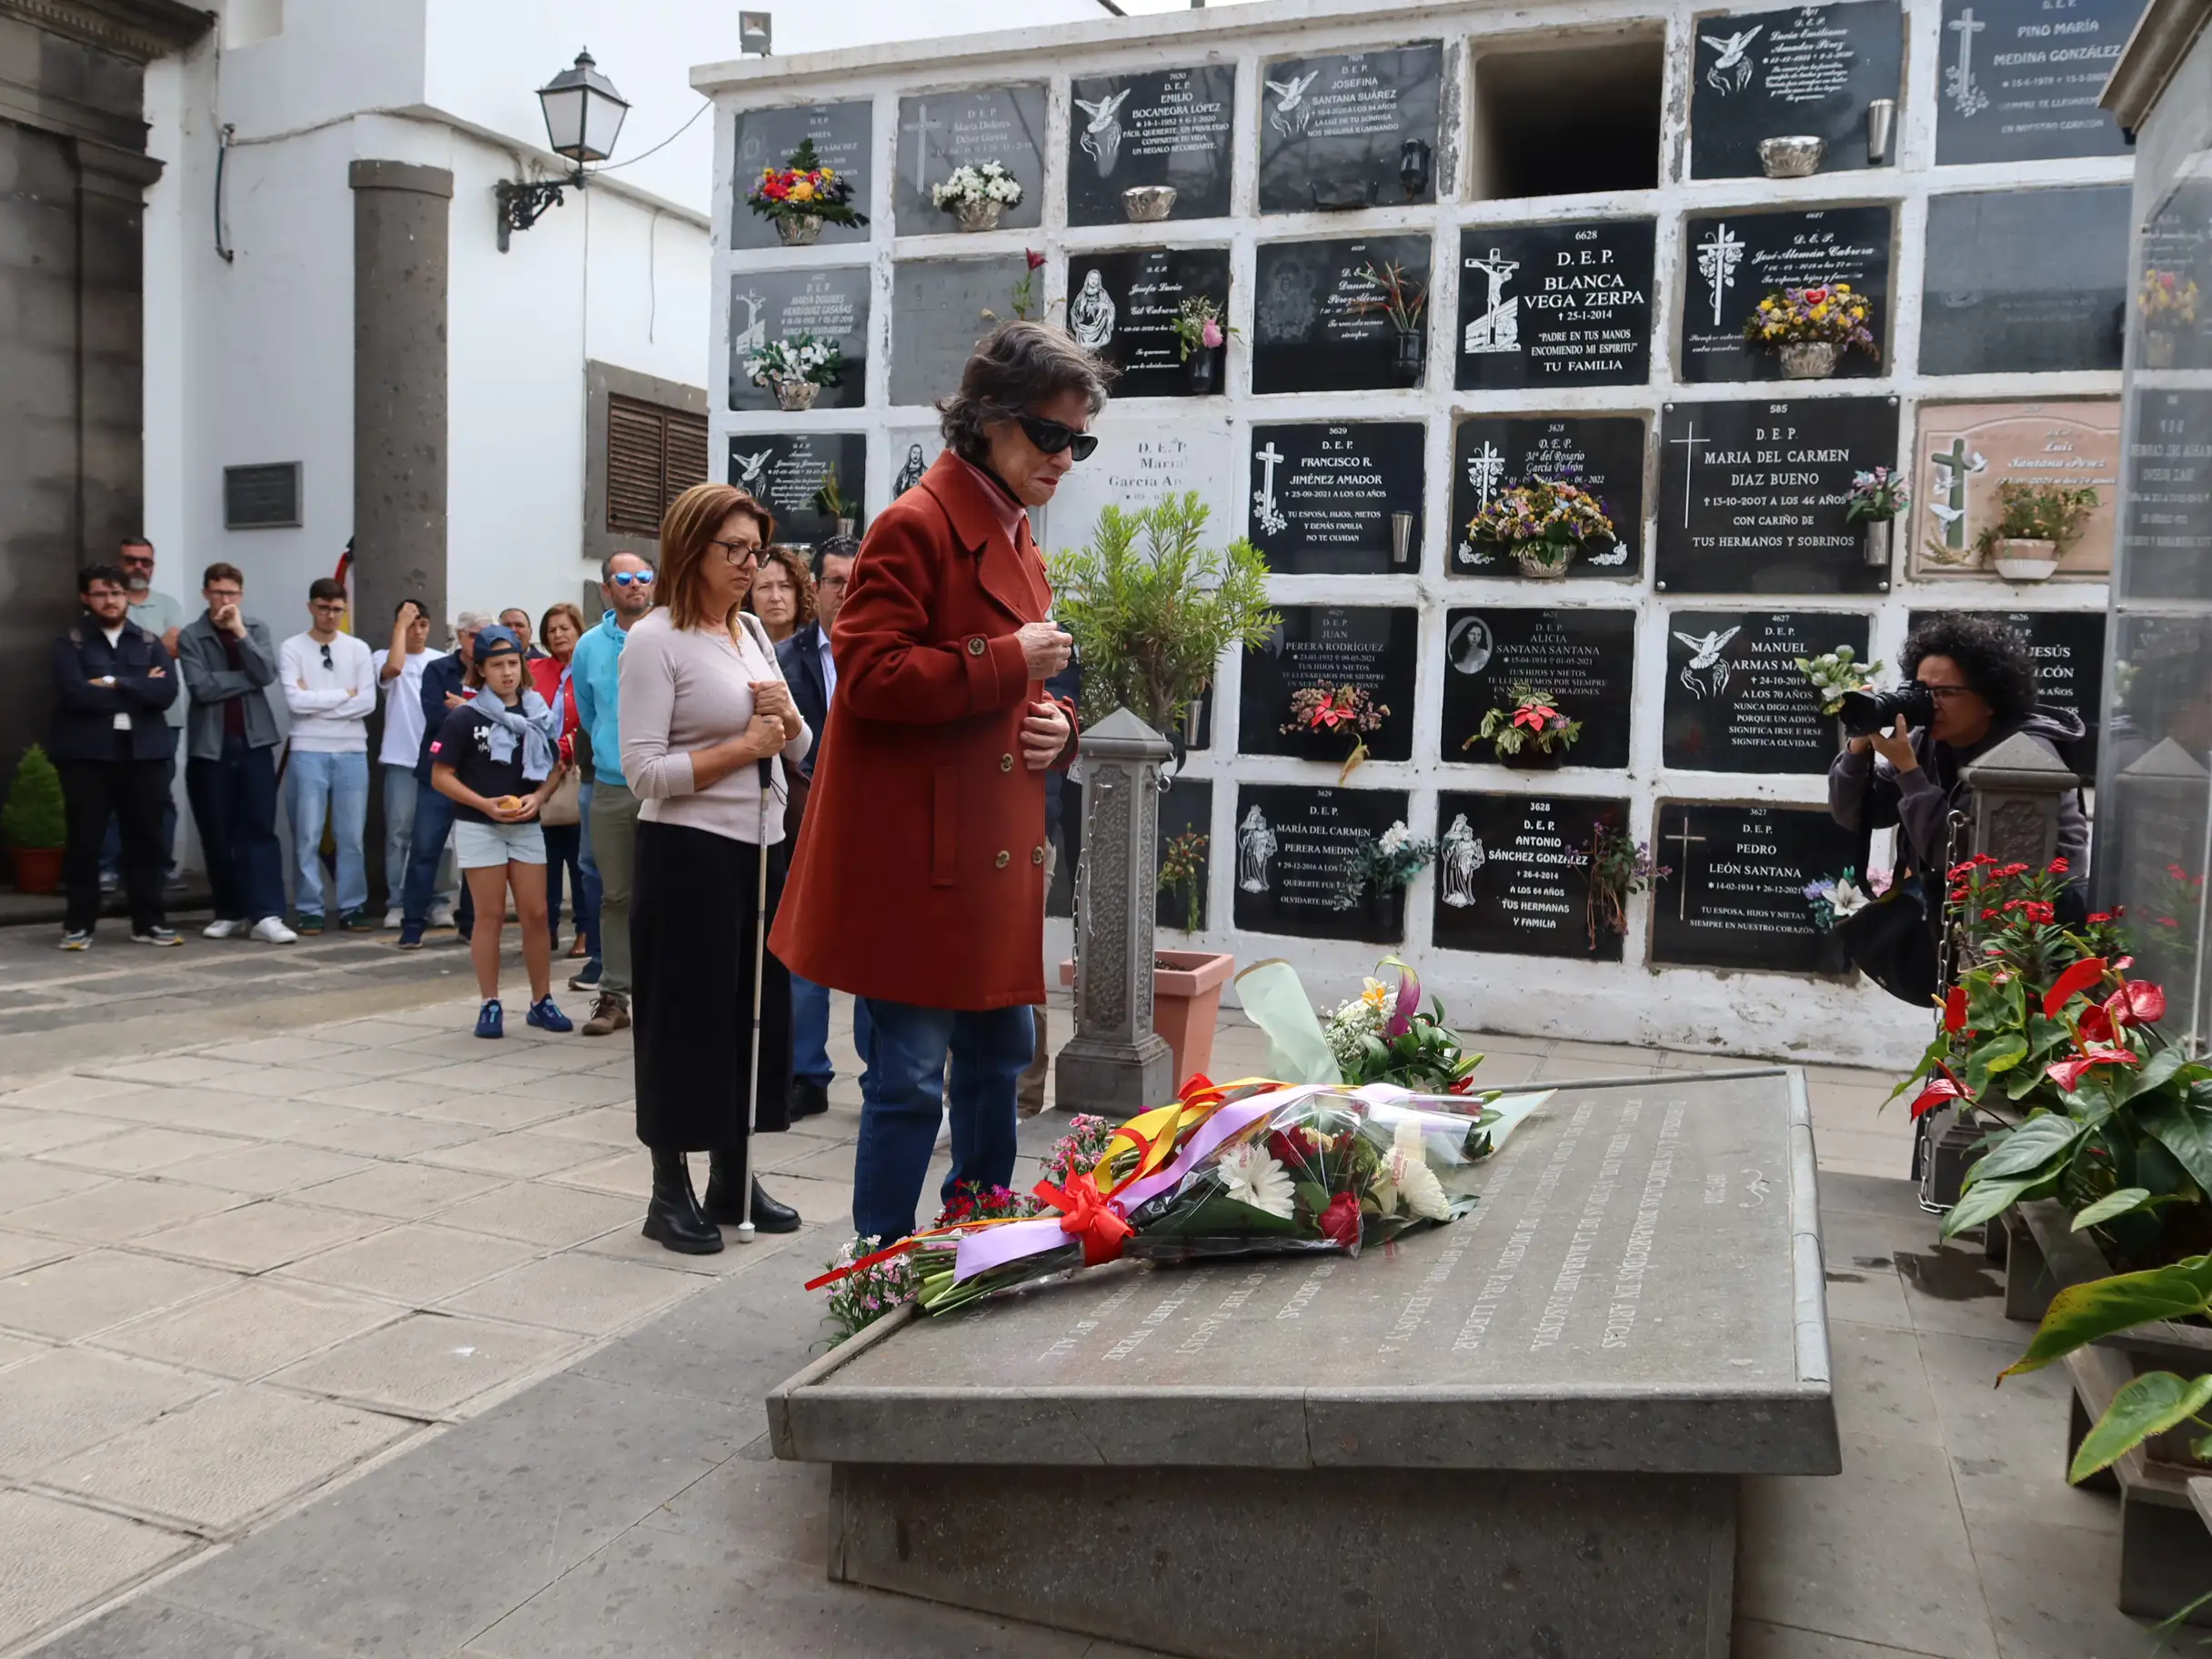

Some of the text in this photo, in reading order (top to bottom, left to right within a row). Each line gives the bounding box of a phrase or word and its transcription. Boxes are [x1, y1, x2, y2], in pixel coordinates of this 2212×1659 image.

[2017, 18, 2099, 38] PINO MARÍA
[1994, 45, 2121, 65] MEDINA GONZÁLEZ
[1332, 77, 1378, 89] JOSEFINA
[1161, 93, 1193, 104] EMILIO
[1312, 90, 1397, 106] SANTANA SUÁREZ
[1132, 102, 1221, 118] BOCANEGRA LÓPEZ
[1575, 230, 1597, 240] 6628
[1557, 250, 1614, 266] D. E. P.
[1544, 274, 1624, 290] BLANCA
[1524, 291, 1644, 309] VEGA ZERPA
[1567, 310, 1613, 320] 25-1-2014
[1570, 331, 1581, 341] EN
[1584, 331, 1598, 340] TUS
[1603, 329, 1631, 339] MANOS
[1532, 345, 1583, 356] ENCOMIENDO
[1585, 345, 1596, 354] MI
[1543, 360, 1623, 372] TU FAMILIA
[1548, 424, 1564, 432] 5628
[1756, 428, 1766, 440] D.
[1772, 428, 1783, 439] E.
[1322, 441, 1332, 449] D.
[1335, 441, 1343, 449] E.
[1302, 457, 1372, 467] FRANCISCO R.
[1540, 450, 1585, 462] del Rosario
[1704, 449, 1850, 464] MARIA DEL CARMEN
[1526, 463, 1552, 475] García
[1290, 473, 1382, 485] JIMÉNEZ AMADOR
[1731, 473, 1819, 486] DIAZ BUENO
[1366, 489, 1386, 498] AÑOS
[1770, 497, 1777, 505] A
[1781, 497, 1798, 505] LOS
[1802, 496, 1815, 505] 46
[1819, 494, 1846, 505] AÑOS
[1311, 521, 1334, 529] DEMÁS
[1734, 514, 1814, 525] CON CARIÑO DE
[1693, 537, 1855, 547] TUS HERMANOS Y SOBRINOS
[1531, 634, 1567, 643] ALICIA
[1286, 640, 1384, 652] PERERA RODRÍGUEZ
[1496, 645, 1600, 656] SANTANA SANTANA
[1751, 643, 1807, 653] MANUEL
[2028, 644, 2071, 658] JESÚS
[1732, 661, 1777, 670] ARMAS
[1760, 677, 1806, 686] 24-10-2019
[1751, 690, 1771, 699] LOS
[1785, 688, 1813, 699] AÑOS
[1734, 703, 1765, 711] NUNCA
[1766, 703, 1789, 711] DIGO
[1737, 715, 1772, 724] PORQUE
[1788, 714, 1816, 724] ADIÓS
[1729, 727, 1773, 735] SIGNIFICA
[1804, 728, 1824, 736] IRSE
[1732, 738, 1819, 748] SIGNIFICA OLVIDAR.
[1530, 802, 1550, 811] 3628
[1277, 823, 1371, 837] MARÍA DEL CARMEN
[1516, 836, 1562, 847] ANTONIO
[1285, 843, 1360, 856] PERERA MEDINA
[1489, 849, 1533, 862] SÁNCHEZ
[1737, 844, 1776, 855] PEDRO
[1523, 870, 1558, 880] 26-4-2014
[1710, 862, 1802, 879] LEÓN SANTANA
[1517, 886, 1531, 894] LOS
[1533, 887, 1542, 895] 64
[1544, 886, 1564, 896] AÑOS
[1716, 882, 1801, 894] 14-02-1934 26-12-2021
[1281, 897, 1319, 905] OLVIDARTE
[1503, 900, 1570, 913] TUS HERMANAS
[1714, 907, 1745, 916] ESPOSA,
[1746, 910, 1769, 918] HIJOS
[1778, 911, 1805, 920] NIETAS
[1513, 917, 1556, 929] Y FAMILIA
[1690, 920, 1724, 929] SIEMPRE
[1737, 922, 1774, 931] NUESTRO
[1776, 924, 1815, 934] CORAZÓN
[1452, 1304, 1497, 1351] LLEGAR
[1602, 1302, 1635, 1349] ARUCAS
